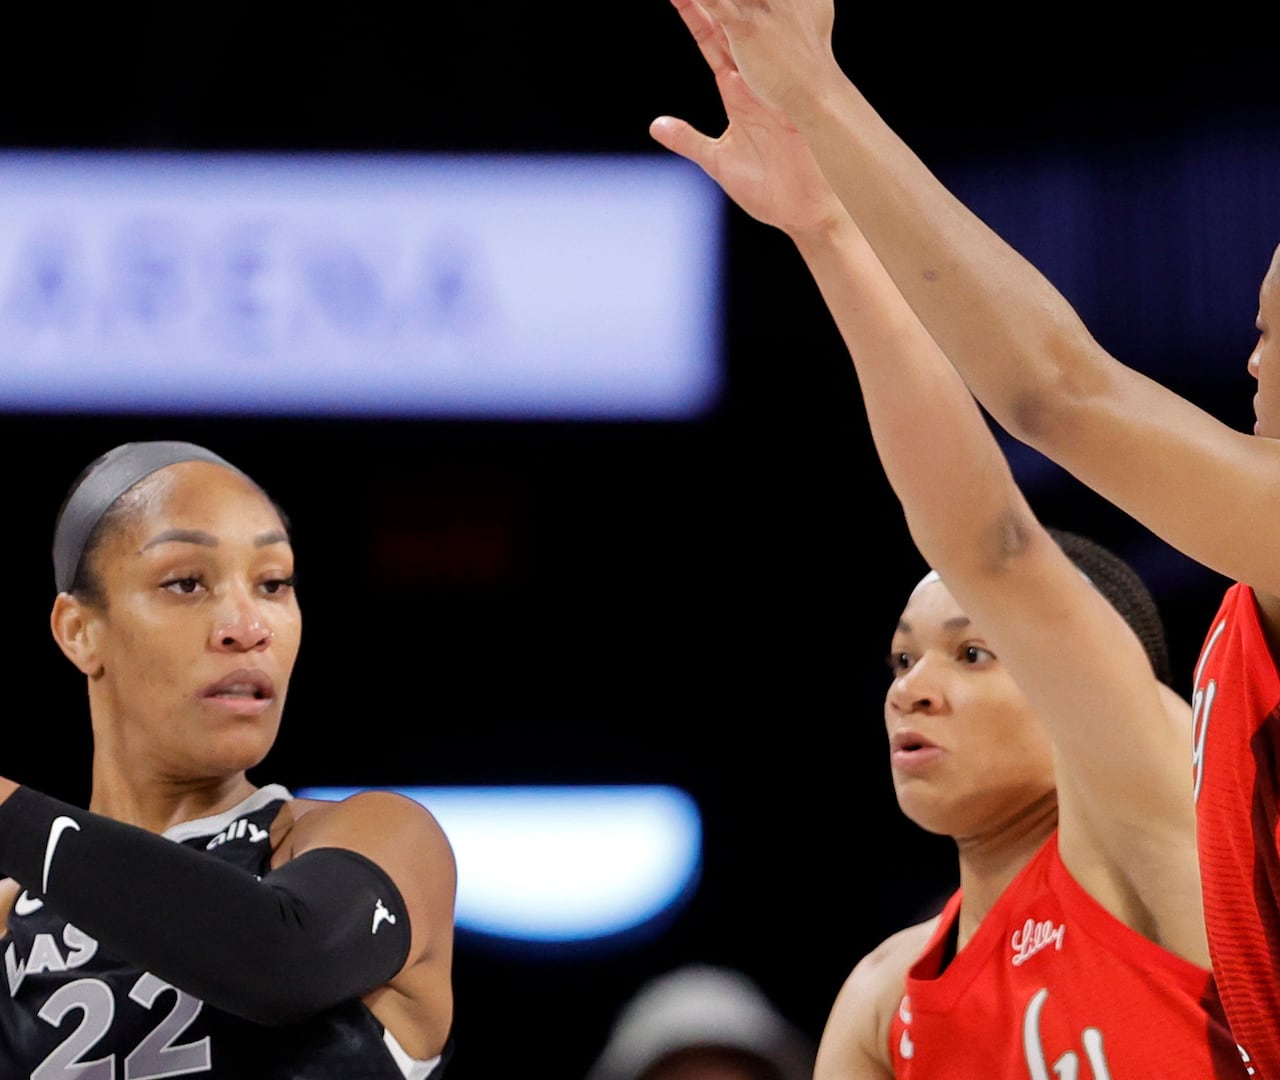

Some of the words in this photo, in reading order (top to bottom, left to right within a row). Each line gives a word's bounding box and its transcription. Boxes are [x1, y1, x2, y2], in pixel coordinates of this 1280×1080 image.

[2, 218, 508, 354] ARENA
[206, 818, 269, 851] ally
[1011, 919, 1066, 967] Lilly
